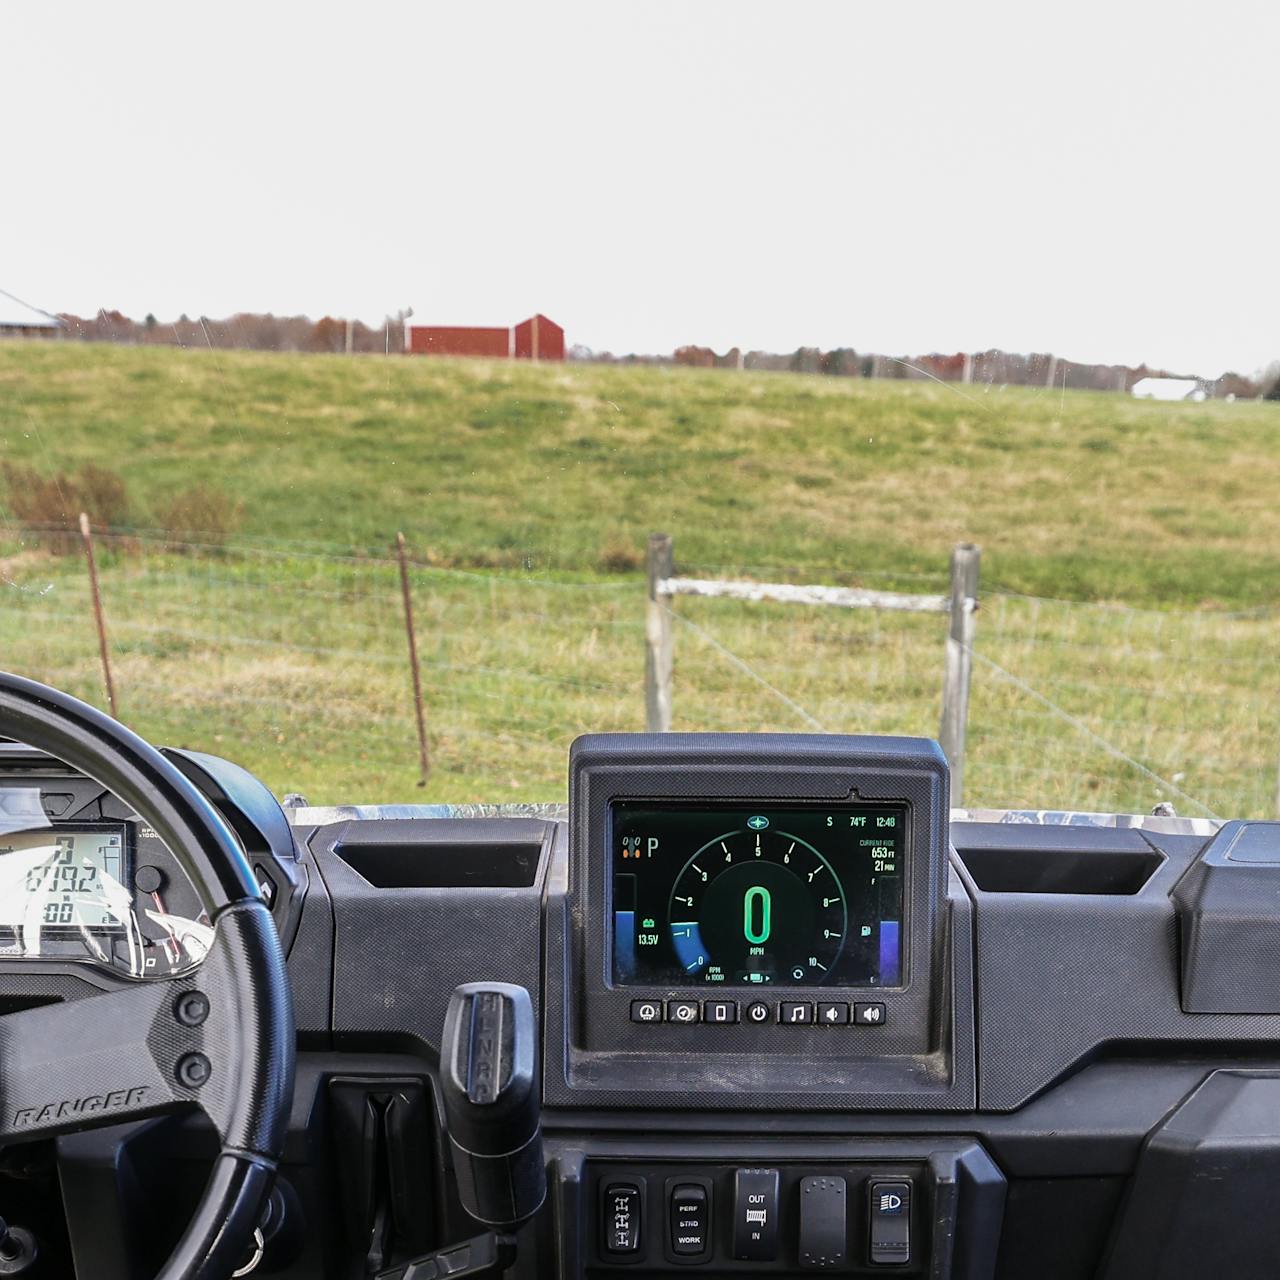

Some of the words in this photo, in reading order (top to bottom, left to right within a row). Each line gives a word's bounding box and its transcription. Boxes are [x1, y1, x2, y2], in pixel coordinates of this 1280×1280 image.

[826, 816, 833, 827] S
[849, 816, 867, 827] 74°F
[876, 816, 896, 827] 12:48
[648, 837, 659, 858] P
[755, 847, 761, 857] 5
[871, 846, 887, 859] 653
[725, 853, 731, 863] 4
[784, 854, 790, 864] 6
[874, 860, 884, 871] 21
[701, 872, 708, 882] 3
[808, 873, 814, 883] 7
[871, 878, 875, 886] F
[687, 897, 693, 907] 2
[823, 898, 829, 908] 8
[744, 886, 771, 945] 0
[686, 929, 690, 938] 1
[823, 929, 829, 939] 9
[638, 934, 659, 946] 13.5V
[750, 947, 764, 956] MPH
[145, 957, 157, 967] 0
[698, 956, 704, 965] 0
[808, 957, 817, 967] 10
[480, 1039, 494, 1057] N
[12, 1085, 151, 1127] RANGER
[748, 1194, 765, 1204] OUT
[678, 1236, 701, 1244] WORK
[752, 1232, 760, 1240] IN
